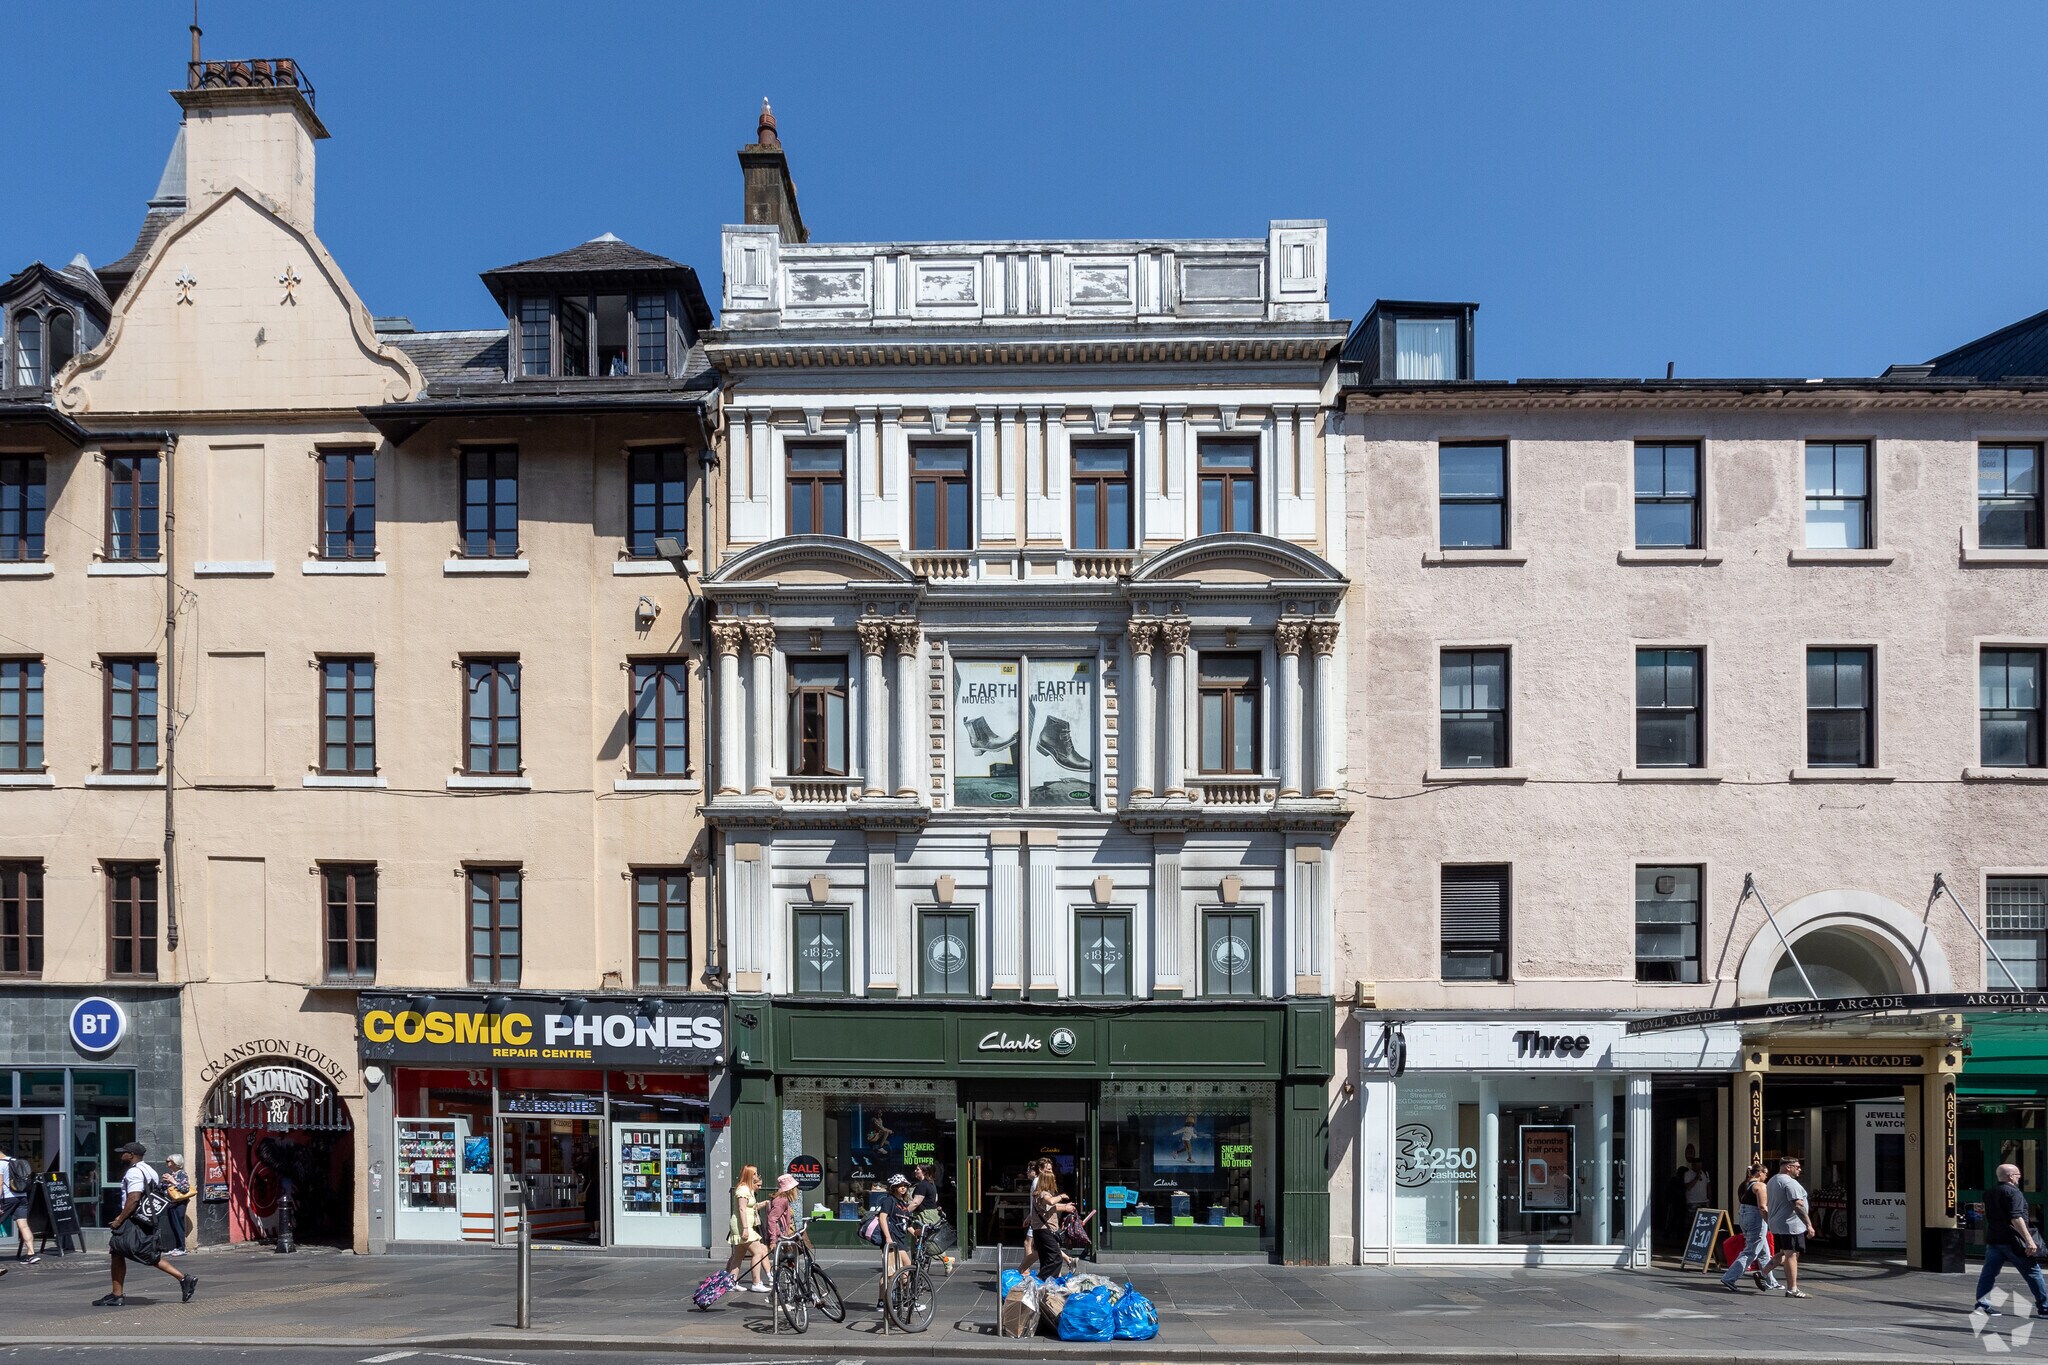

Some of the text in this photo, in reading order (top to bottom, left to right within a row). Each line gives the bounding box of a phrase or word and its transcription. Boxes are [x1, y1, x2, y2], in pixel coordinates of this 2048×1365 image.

[969, 683, 1017, 698] EARTH
[1037, 681, 1086, 695] EARTH
[962, 696, 995, 704] MOVERS
[1030, 694, 1064, 702] MOVERS
[810, 947, 834, 959] 1825
[1091, 949, 1116, 962] 1825
[1836, 997, 1906, 1010] ARCADE
[1967, 994, 2027, 1005] ARGYLL
[82, 1014, 111, 1034] BT
[1672, 1011, 1720, 1025] ARCADE
[364, 1010, 723, 1049] COSMIC PHONES
[979, 1031, 1042, 1050] Clarks
[1516, 1030, 1590, 1051] Three
[492, 1048, 592, 1059] REPAIR CENTRE
[200, 1039, 348, 1085] CRANSTON HOUSE
[1782, 1056, 1912, 1066] ARGYLL ARCADE
[244, 1069, 309, 1100] SLOANS
[509, 1100, 596, 1113] ACCESSORIES
[267, 1110, 288, 1123] 1797
[1752, 1090, 1760, 1144] ARGYLL
[903, 1142, 935, 1151] SNEAKERS
[1533, 1137, 1564, 1145] months
[1221, 1145, 1253, 1153] SNEAKERS
[1543, 1146, 1563, 1154] price
[1946, 1093, 1955, 1208] ARGYLL ARCADE
[1413, 1147, 1477, 1169] £250
[791, 1164, 820, 1173] SALE
[851, 1171, 876, 1179] Clarks
[1430, 1170, 1477, 1179] cashback
[1153, 1179, 1178, 1187] Clarks
